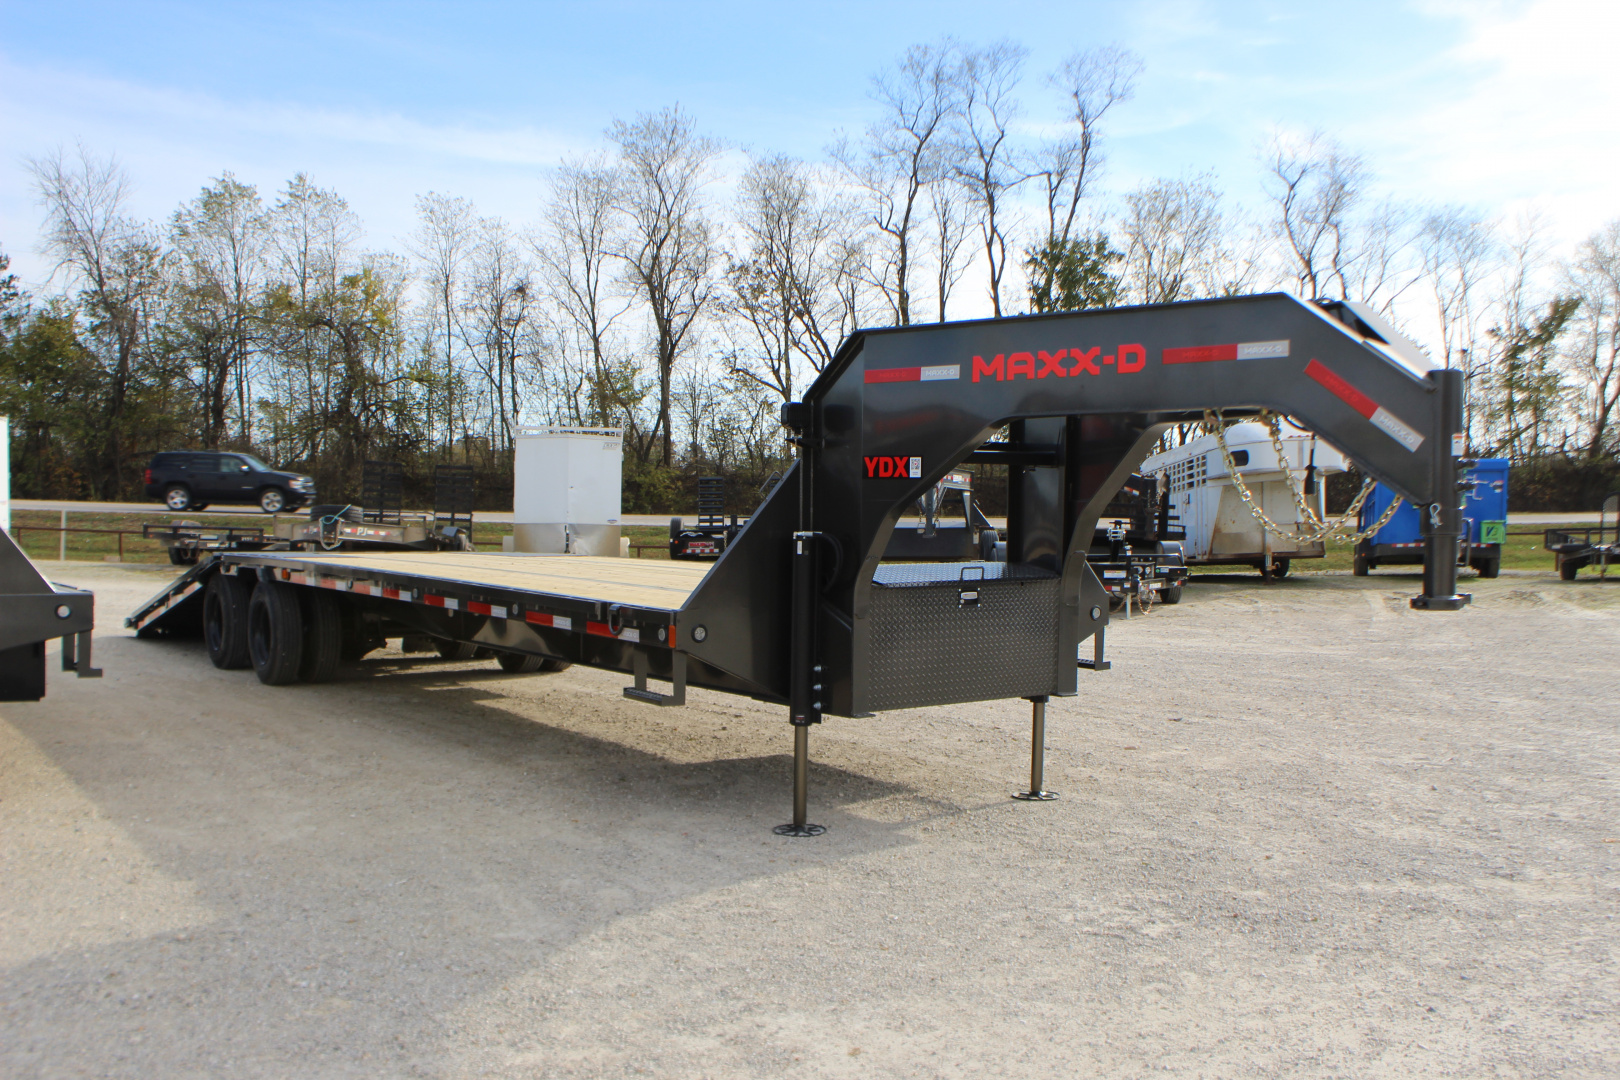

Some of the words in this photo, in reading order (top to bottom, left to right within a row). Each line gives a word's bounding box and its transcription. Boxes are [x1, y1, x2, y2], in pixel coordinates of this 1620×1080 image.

[1244, 345, 1283, 354] MAXX-D
[972, 343, 1146, 383] MAXX-D
[925, 368, 955, 377] MAXX-D
[1379, 415, 1415, 444] MAXX-D
[863, 456, 909, 477] YDX
[356, 527, 368, 536] PJ
